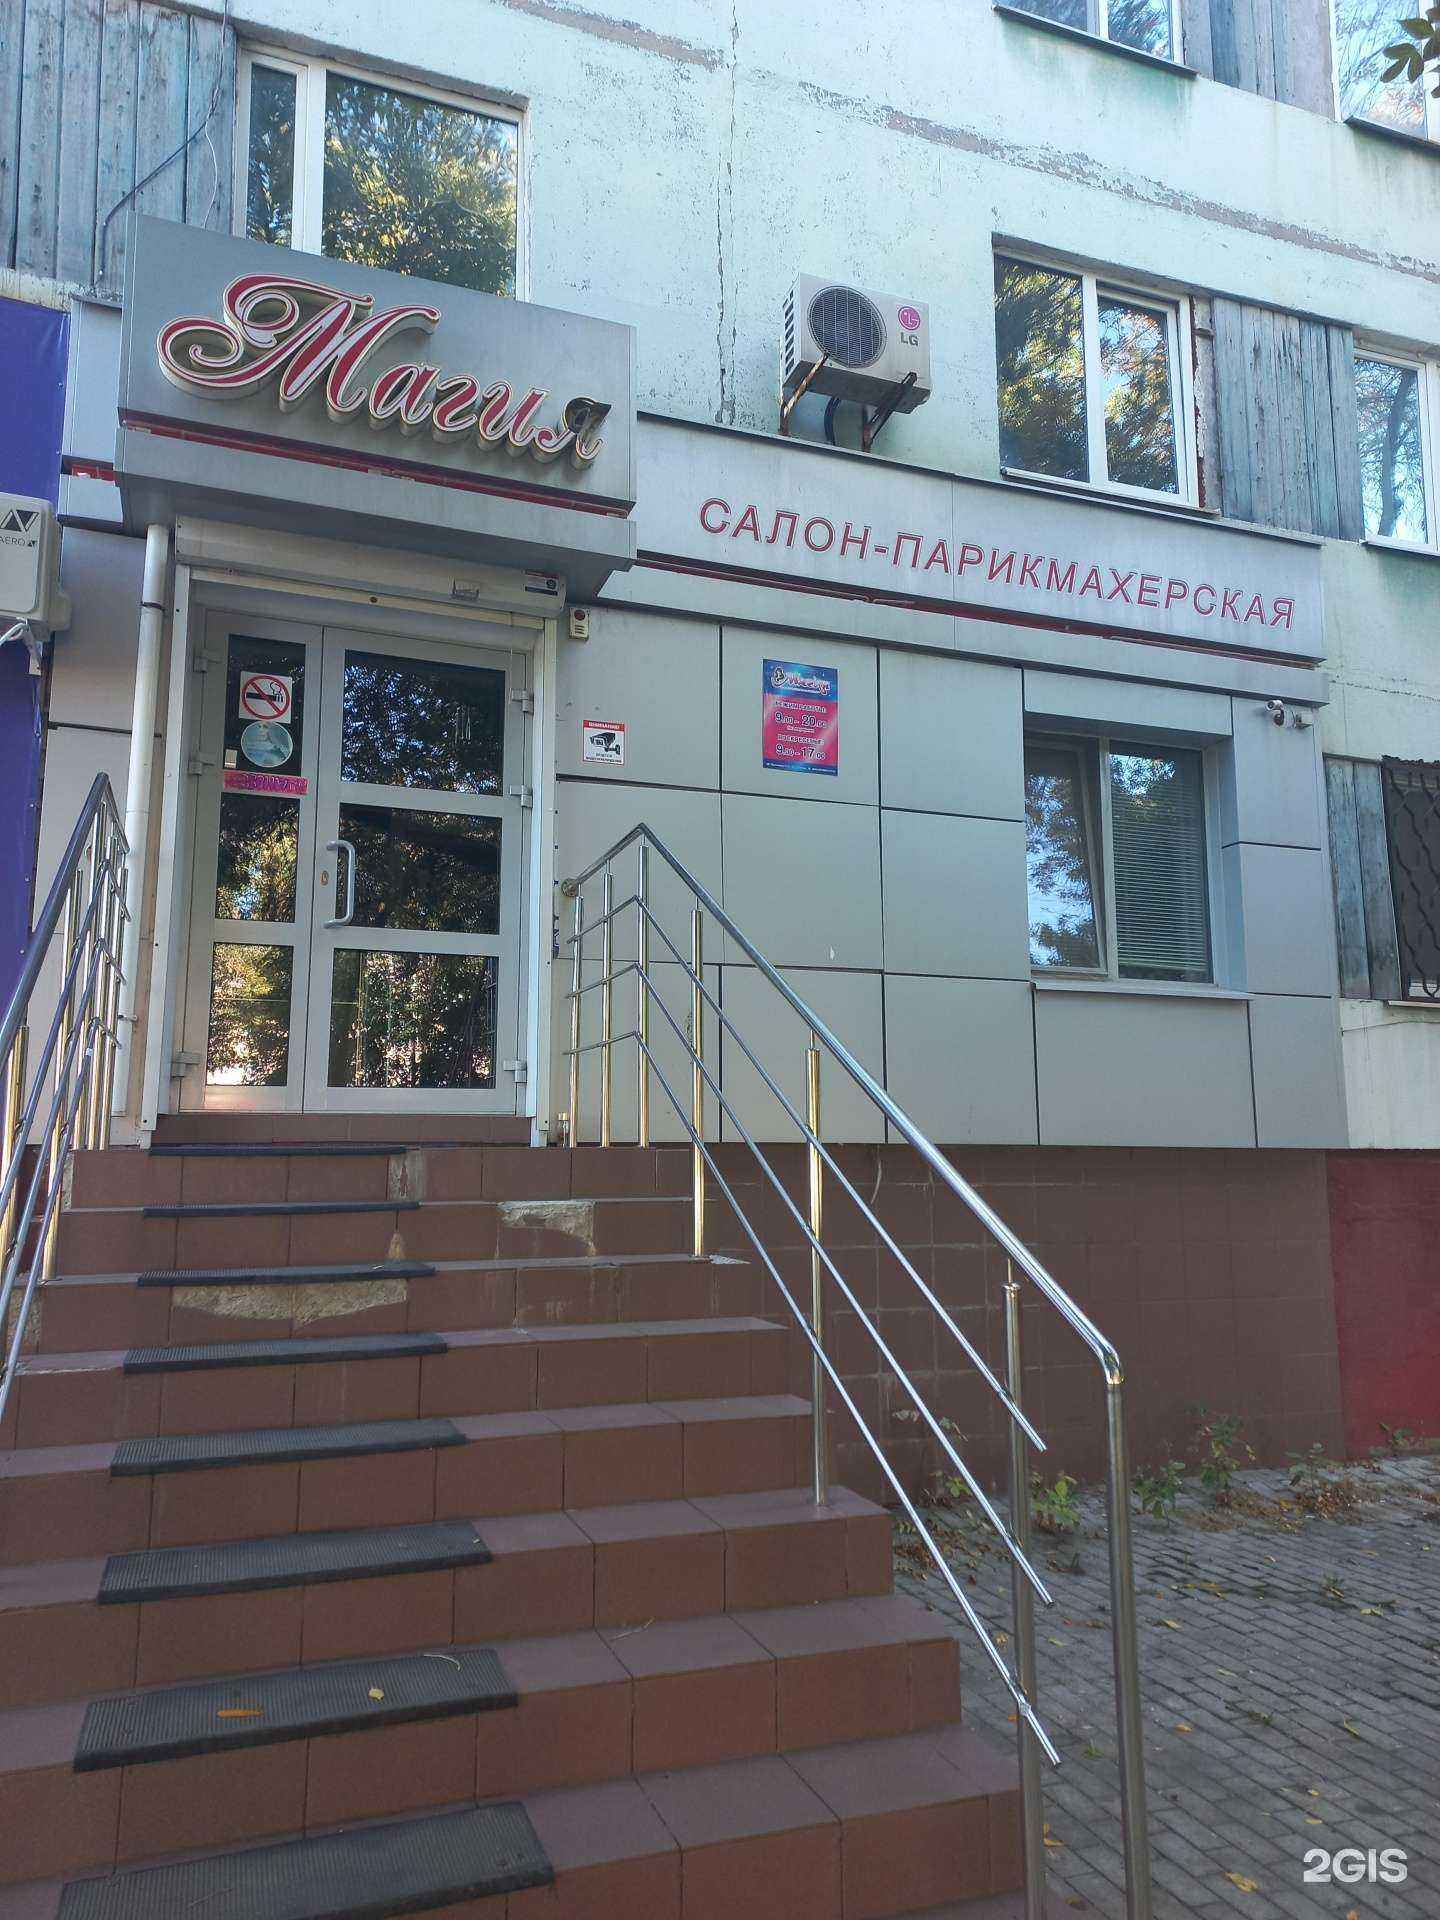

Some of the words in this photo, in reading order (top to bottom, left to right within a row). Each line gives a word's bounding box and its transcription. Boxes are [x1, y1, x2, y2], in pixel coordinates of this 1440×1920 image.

[157, 272, 612, 468] Магия
[900, 333, 919, 347] LG
[699, 497, 1296, 630] САЛОН-ПАРИКМАХЕРСКАЯ
